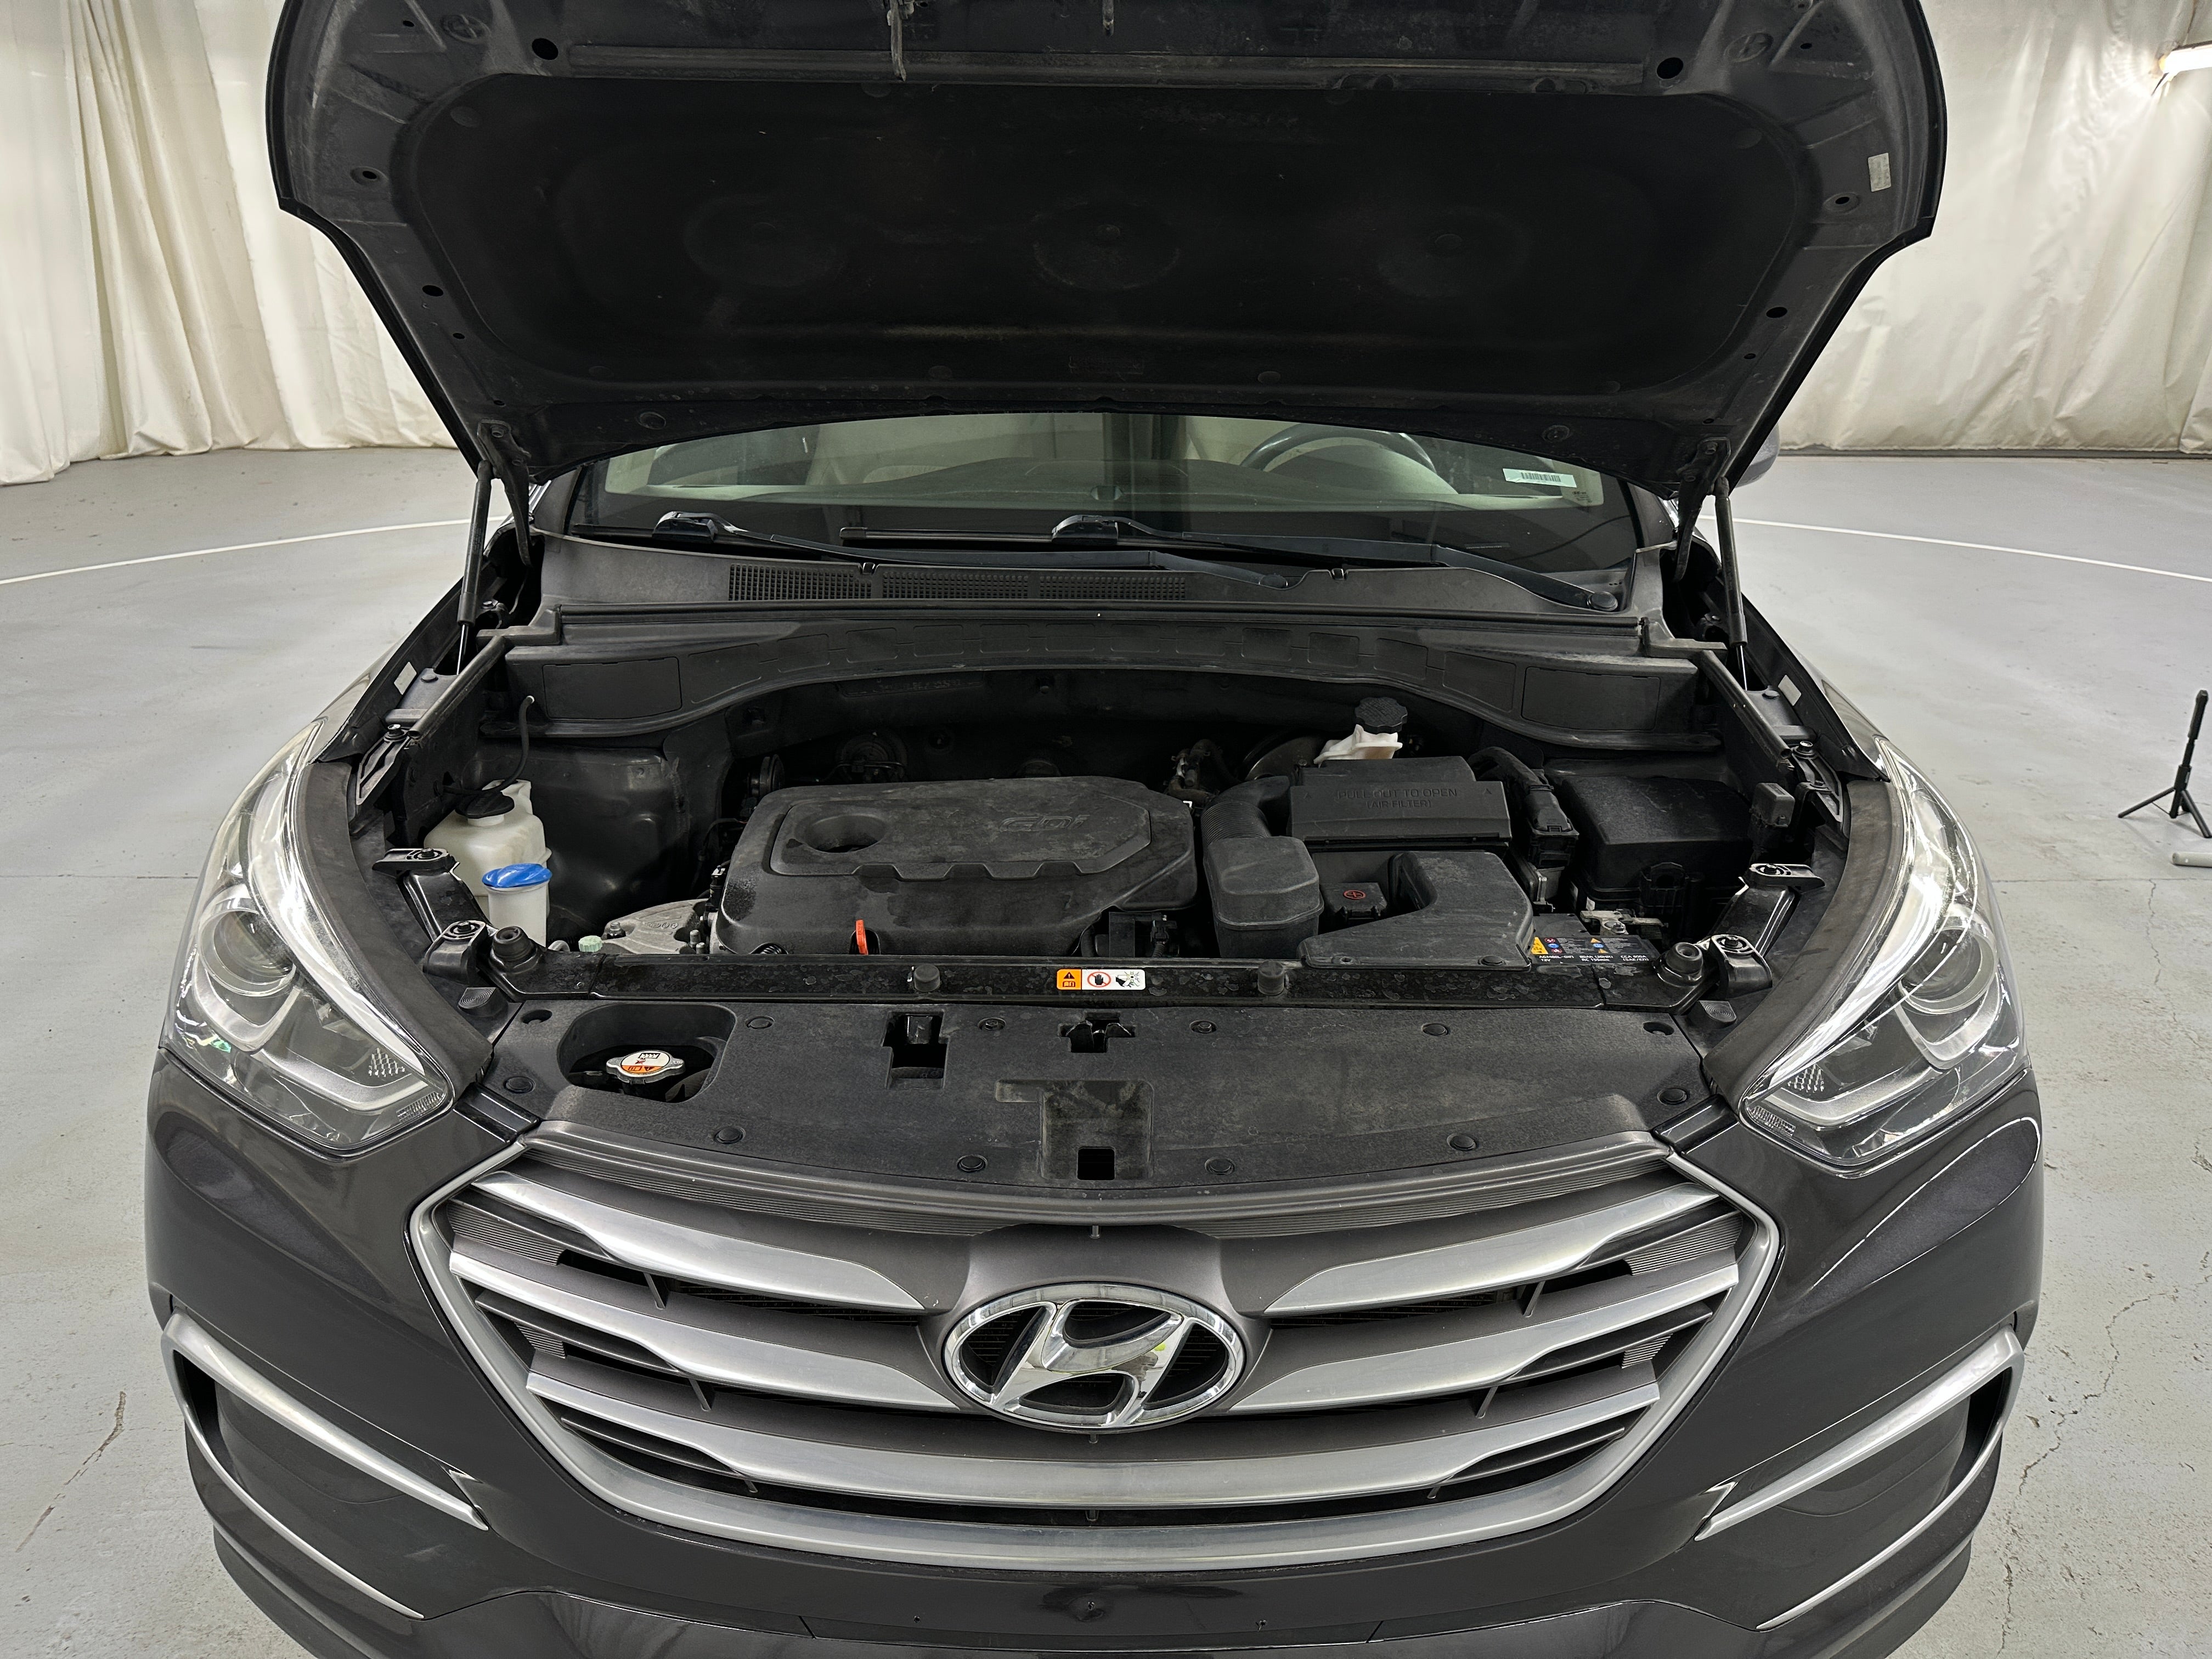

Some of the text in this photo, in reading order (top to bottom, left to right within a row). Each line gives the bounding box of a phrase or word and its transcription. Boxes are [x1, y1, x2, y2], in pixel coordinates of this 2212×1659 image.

[1373, 789, 1397, 798] OUT
[1404, 789, 1419, 798] TO
[1422, 788, 1458, 798] OPEN
